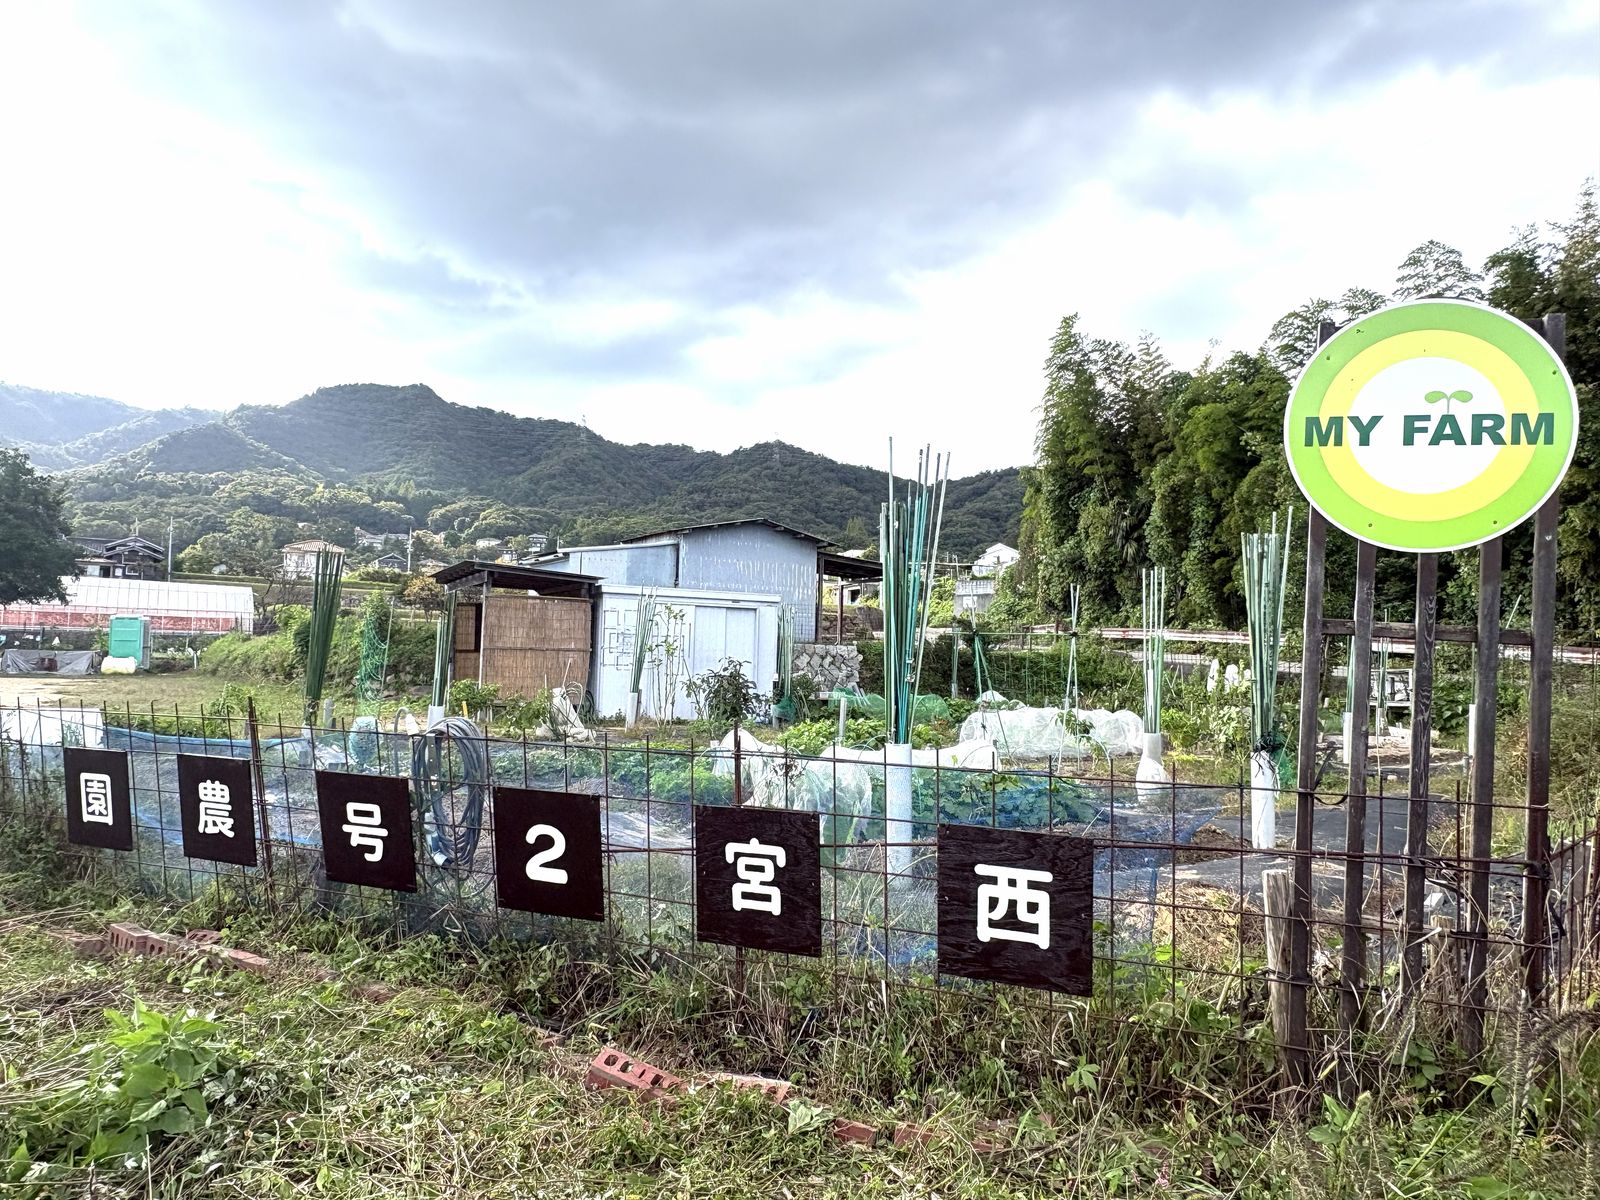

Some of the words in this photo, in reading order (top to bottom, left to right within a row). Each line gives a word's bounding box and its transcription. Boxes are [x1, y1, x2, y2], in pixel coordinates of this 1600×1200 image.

[1304, 415, 1384, 447] MY
[1402, 412, 1555, 447] FARM
[79, 772, 114, 826] 園
[197, 779, 235, 838] 農
[341, 801, 389, 863] 号
[525, 823, 569, 885] 2
[724, 837, 787, 916] 宮
[974, 863, 1054, 950] 西
